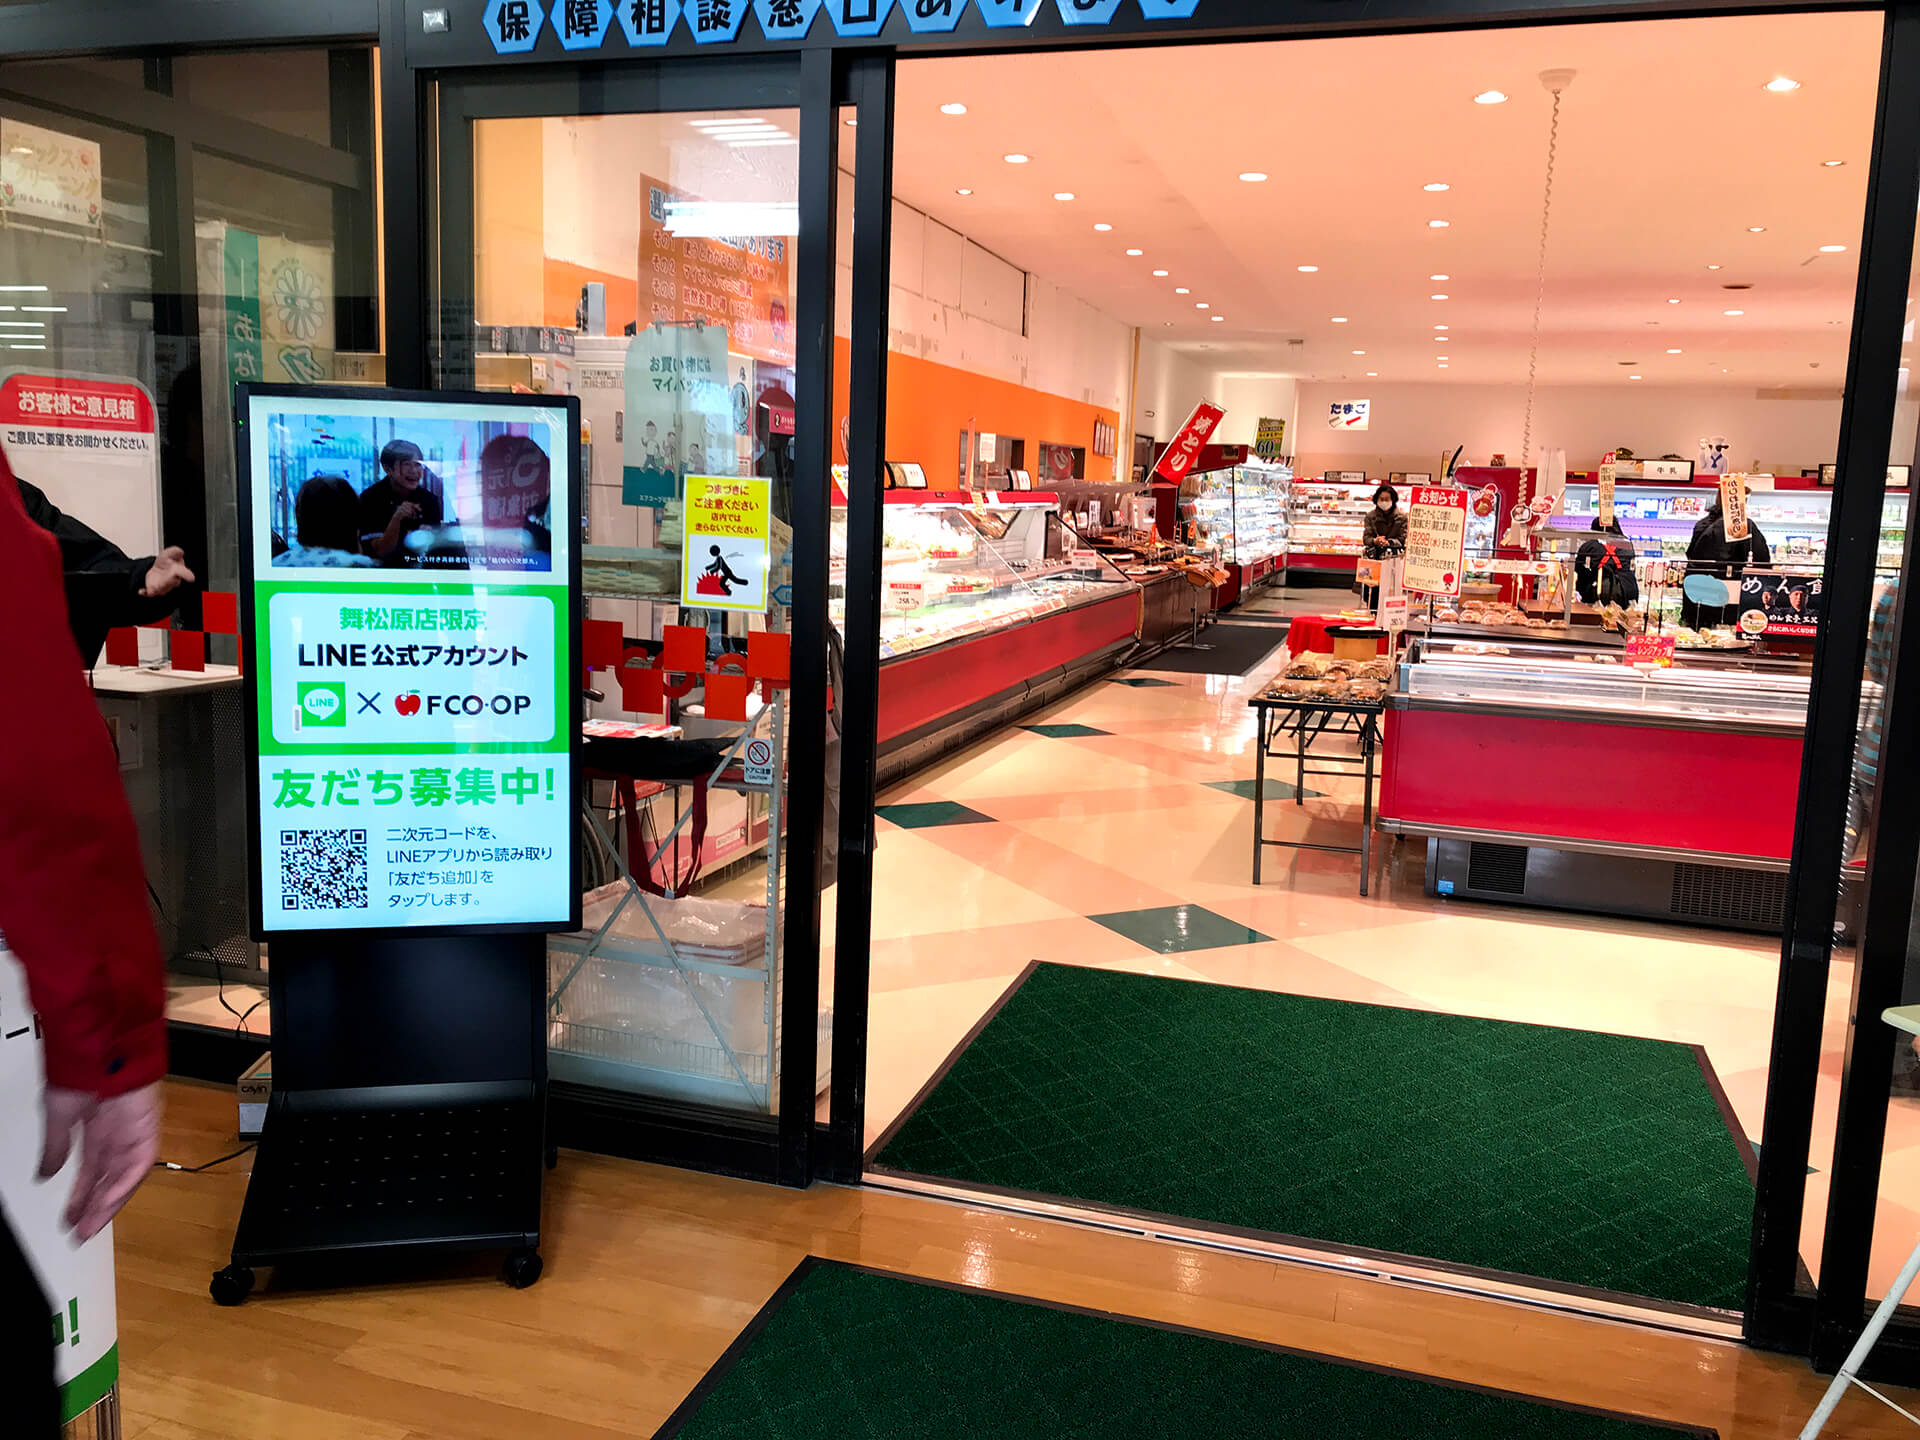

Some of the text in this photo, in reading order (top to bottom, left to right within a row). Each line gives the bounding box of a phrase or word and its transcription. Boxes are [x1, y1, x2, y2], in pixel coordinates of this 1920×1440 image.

[18, 390, 136, 420] お客様ご意見箱
[705, 484, 750, 495] つまづきに
[694, 498, 759, 511] ご注意ください
[1419, 490, 1459, 506] お知らせ
[711, 512, 742, 522] 店内では
[695, 523, 758, 534] 走らないでください
[339, 606, 488, 631] 舞松原店限定
[298, 643, 528, 667] LINE公式アカウント
[309, 696, 335, 708] LINE
[272, 767, 554, 808] 友だち募集中!
[386, 827, 498, 842] 二次元コードを、
[386, 846, 553, 864] LINEアプリから読み取り
[388, 869, 494, 887] 「友だち追加」を
[388, 892, 481, 908] タップします。
